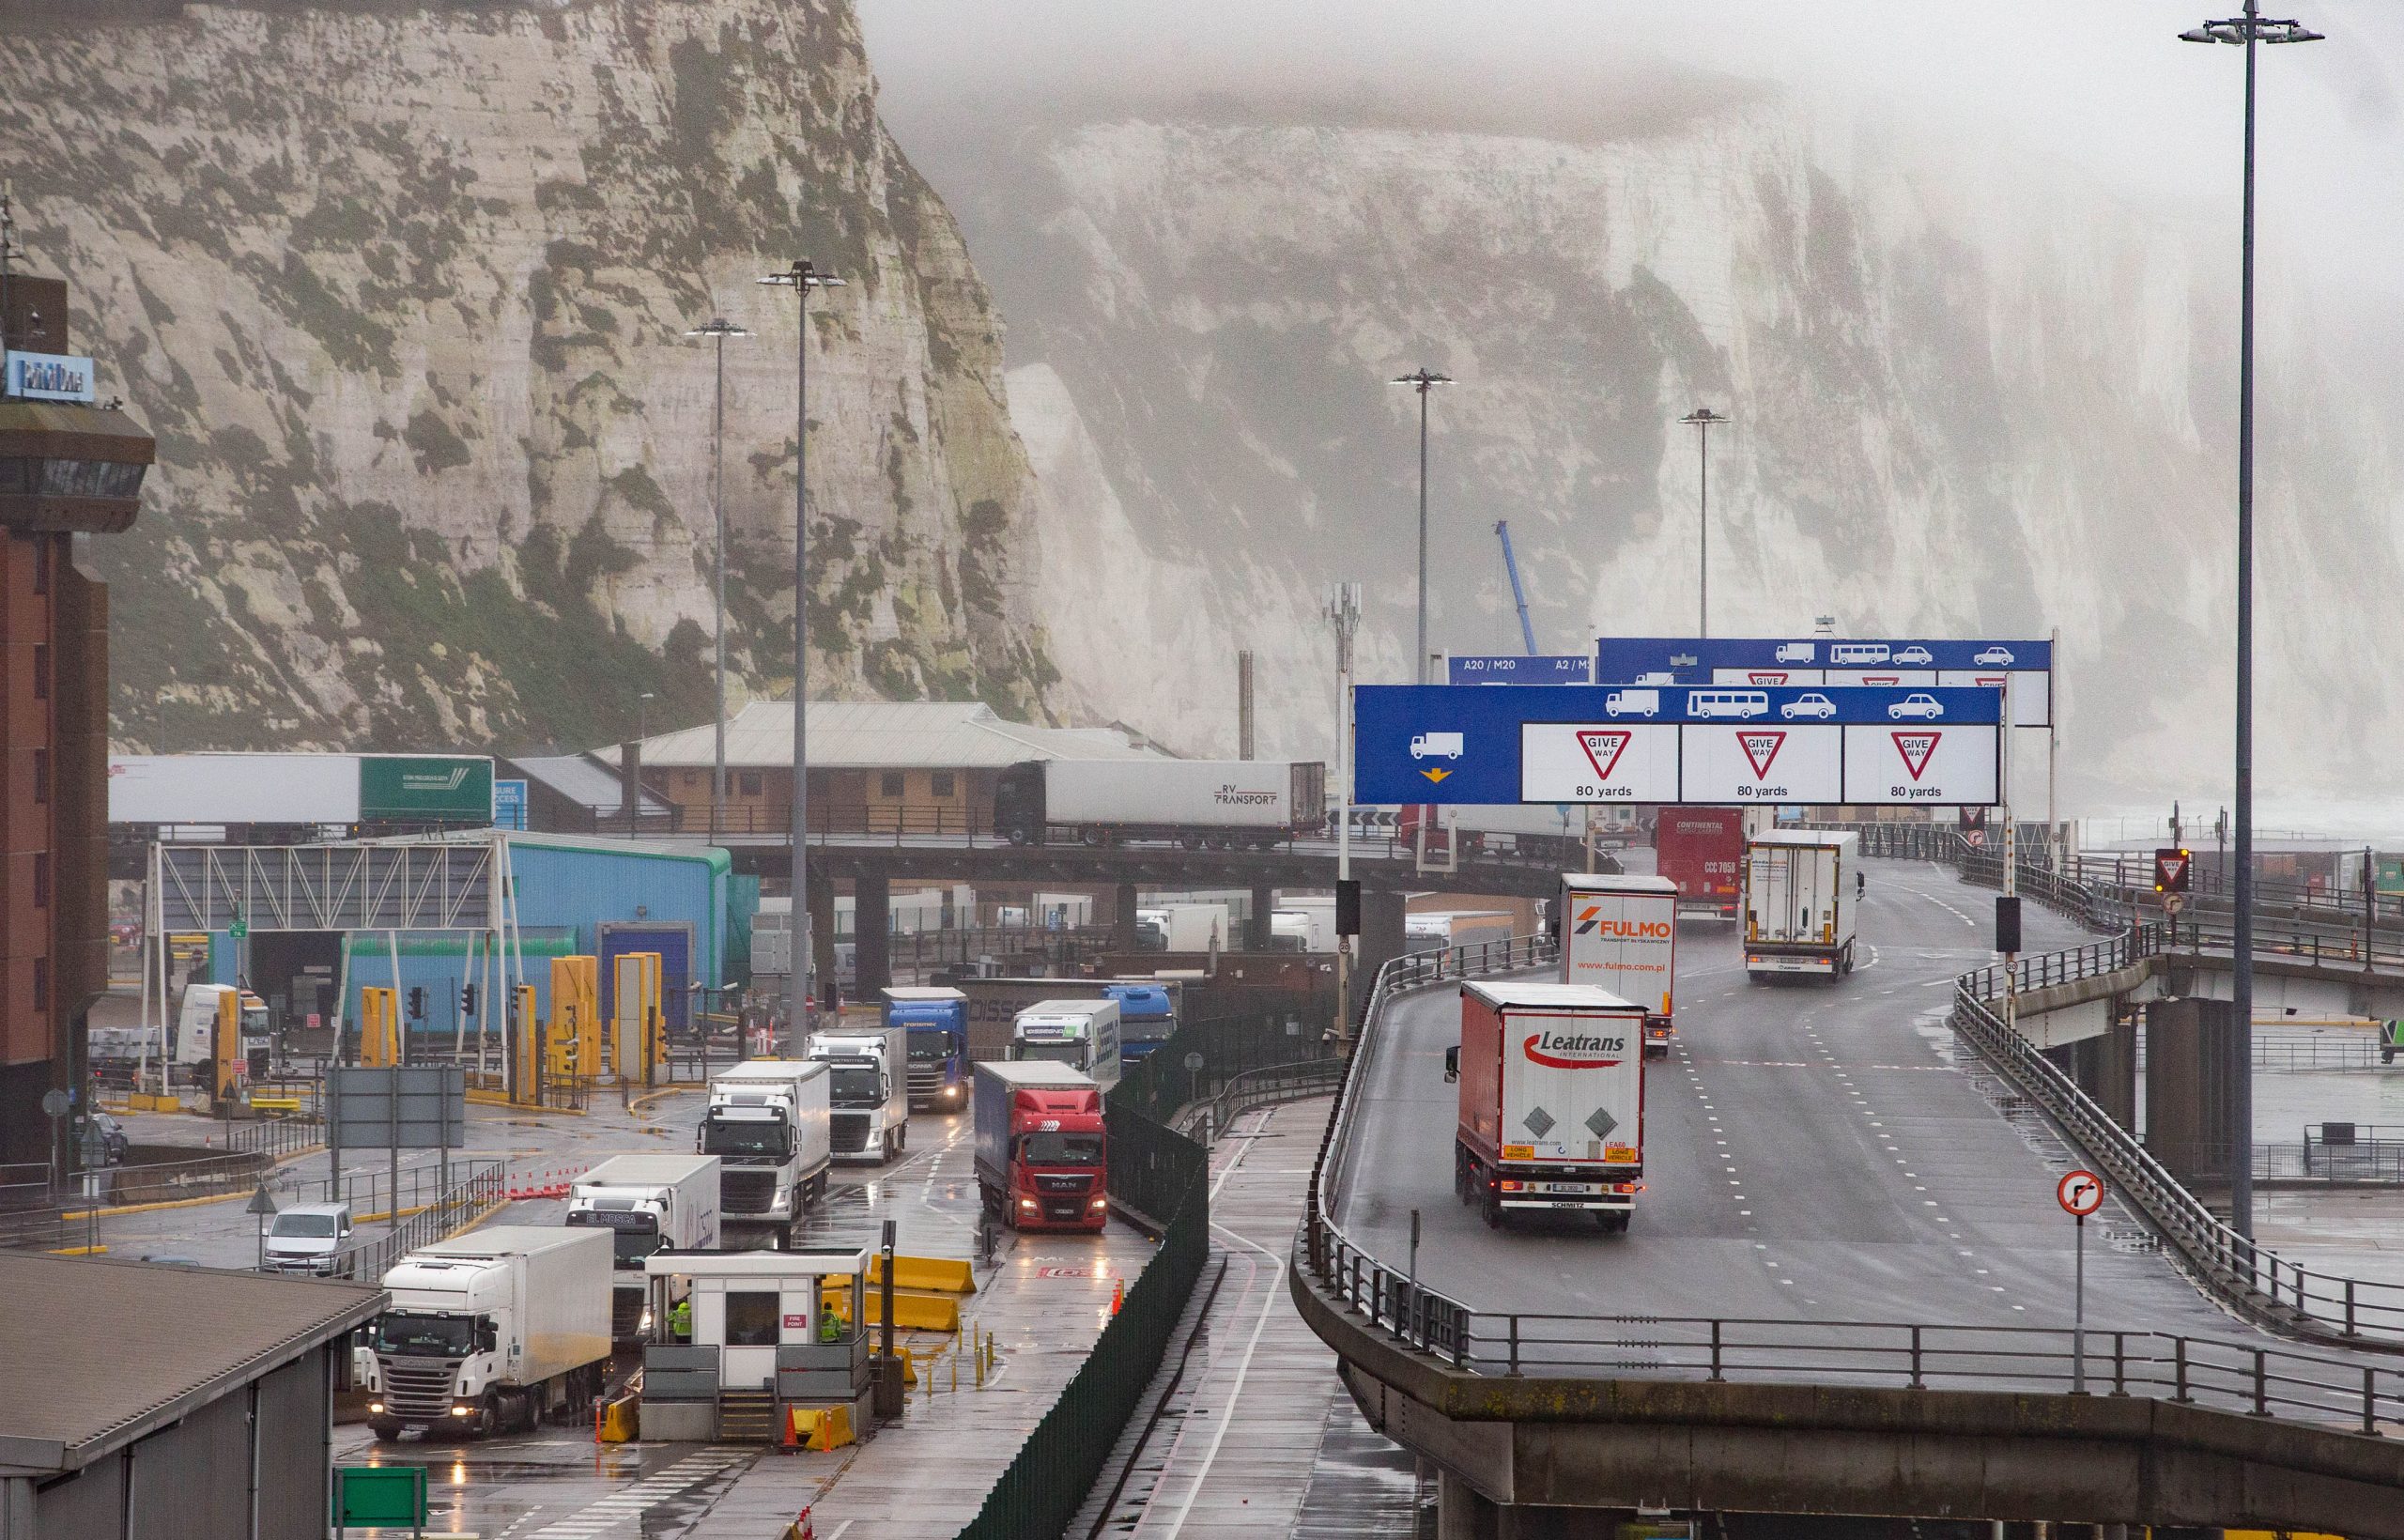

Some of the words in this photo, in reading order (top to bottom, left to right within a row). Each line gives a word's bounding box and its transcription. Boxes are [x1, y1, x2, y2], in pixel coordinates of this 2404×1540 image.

[1464, 660, 1484, 670] A20
[1494, 660, 1515, 670] M20
[1555, 660, 1568, 670] A2
[1579, 660, 1589, 670] M
[1588, 737, 1618, 747] GIVE
[1748, 739, 1773, 748] GIVE
[1903, 739, 1928, 748] GIVE
[1223, 784, 1236, 793] RV
[1576, 785, 1594, 795] 80
[1597, 785, 1632, 798] yards
[1737, 786, 1752, 795] 80
[1755, 786, 1788, 798] yards
[1891, 786, 1905, 796] 80
[1908, 786, 1942, 799] yards
[1214, 794, 1277, 805] TRANSPORT
[1676, 821, 1723, 829] CONTINENTAL
[1704, 861, 1717, 873] CCC
[1718, 861, 1735, 874] 7058
[1600, 920, 1671, 938] FULMO
[1578, 962, 1666, 973] www.fulmo.com.pl
[1540, 1031, 1626, 1052] Leatrans
[587, 1213, 599, 1224] EL
[601, 1213, 637, 1224] MOSCA
[400, 1358, 437, 1367] SCANIA
